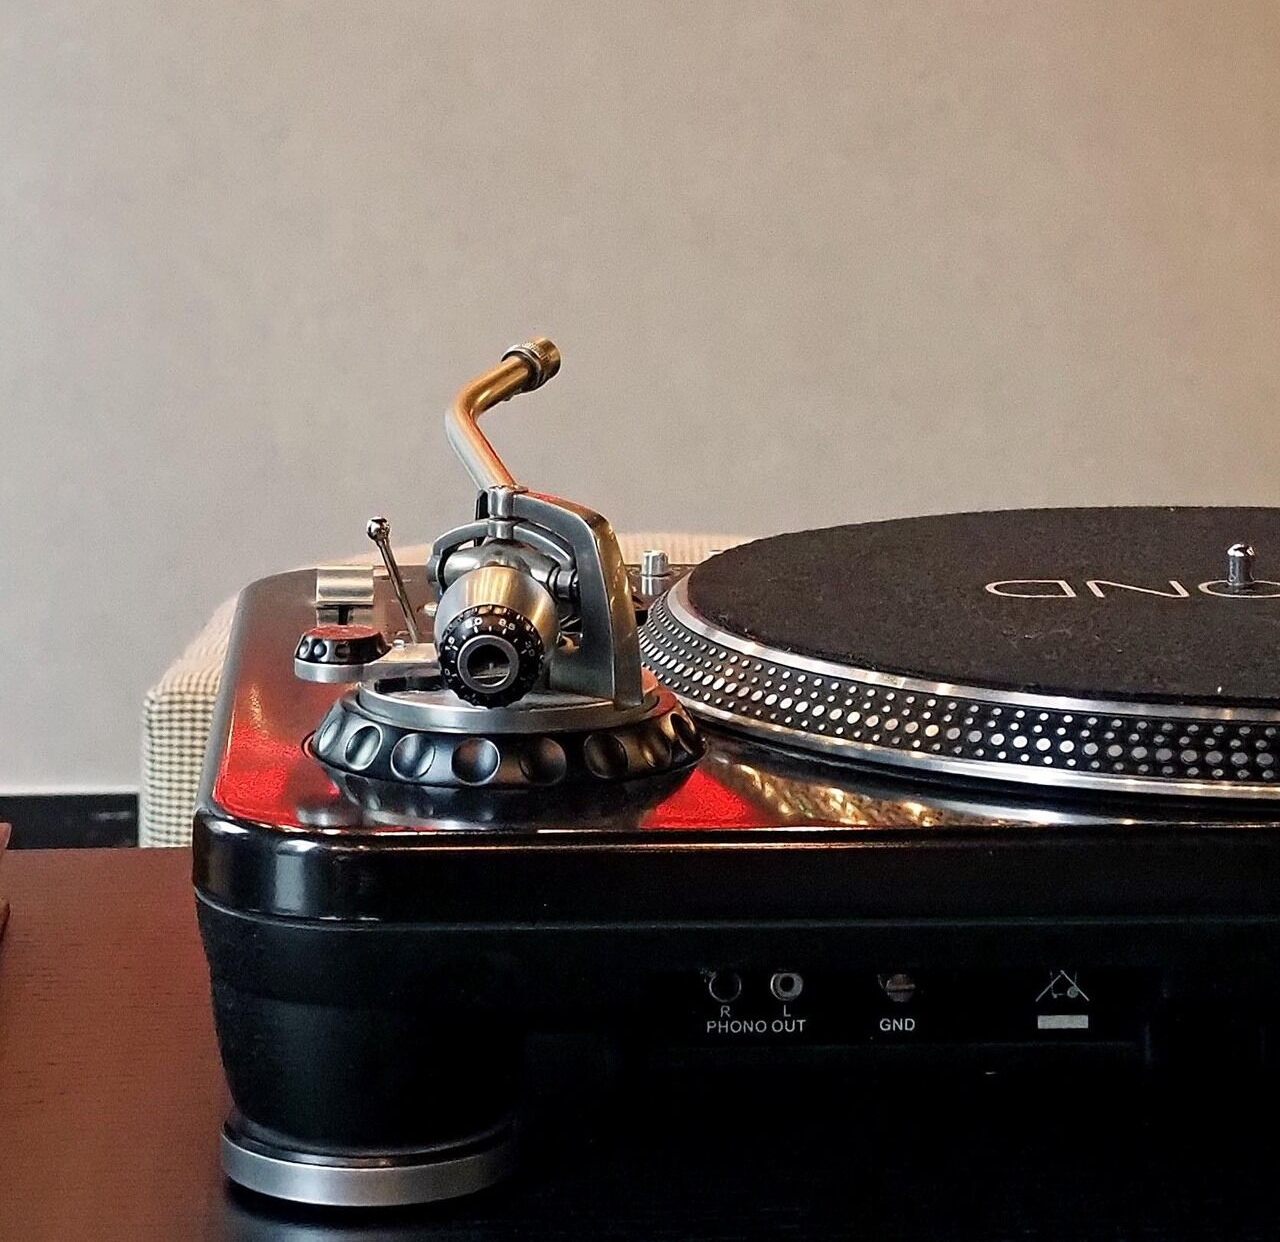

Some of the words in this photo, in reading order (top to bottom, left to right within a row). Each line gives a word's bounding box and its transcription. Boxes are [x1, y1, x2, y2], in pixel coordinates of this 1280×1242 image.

[720, 1005, 731, 1018] R
[783, 1004, 791, 1018] L
[706, 1019, 767, 1034] PHONO
[771, 1019, 807, 1033] OUT
[879, 1018, 916, 1032] GND
